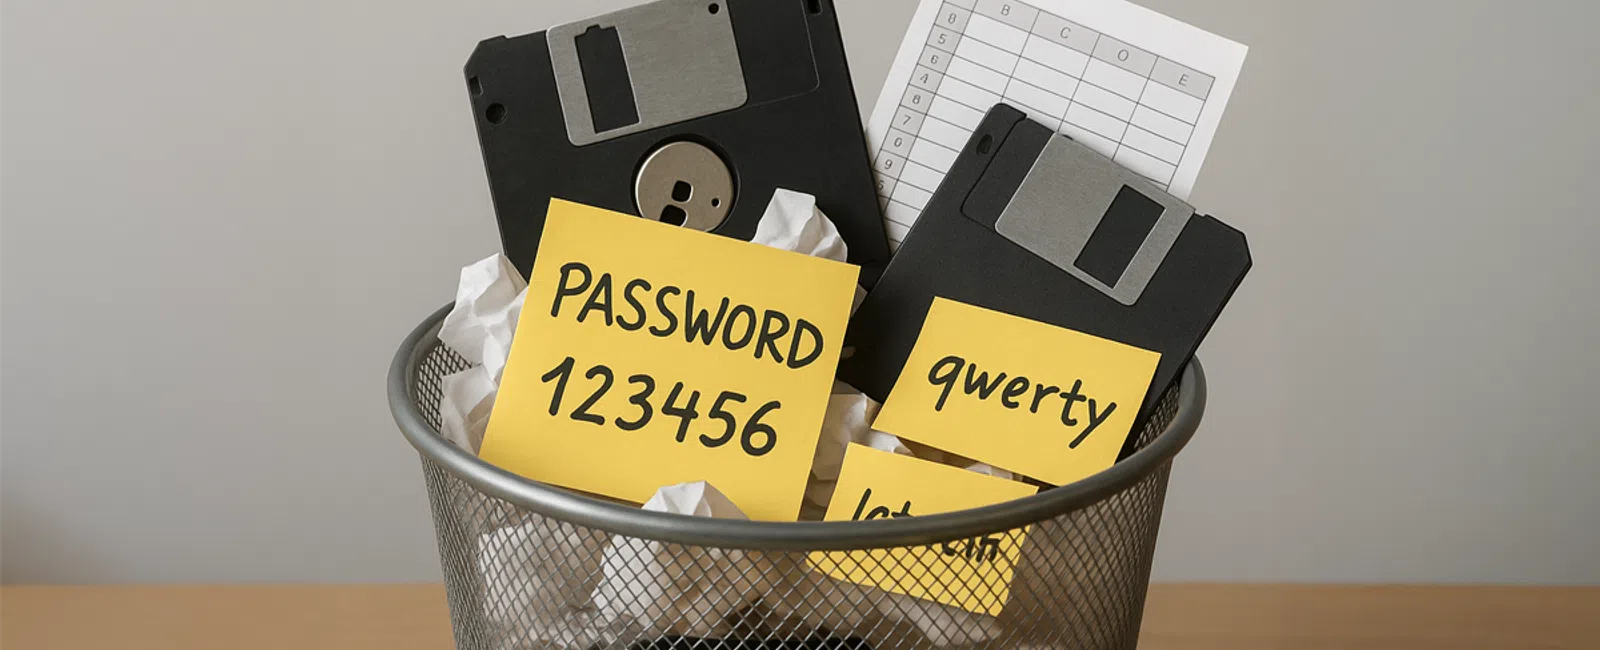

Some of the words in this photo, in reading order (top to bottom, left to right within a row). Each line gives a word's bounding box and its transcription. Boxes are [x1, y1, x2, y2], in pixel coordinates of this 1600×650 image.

[1000, 4, 1011, 17] B
[1059, 26, 1072, 40] C
[1178, 73, 1190, 87] E
[883, 158, 894, 170] 9
[902, 114, 912, 126] 7
[550, 261, 824, 370] PASSWORD
[541, 356, 782, 457] 123456
[928, 355, 1118, 450] qwerty
